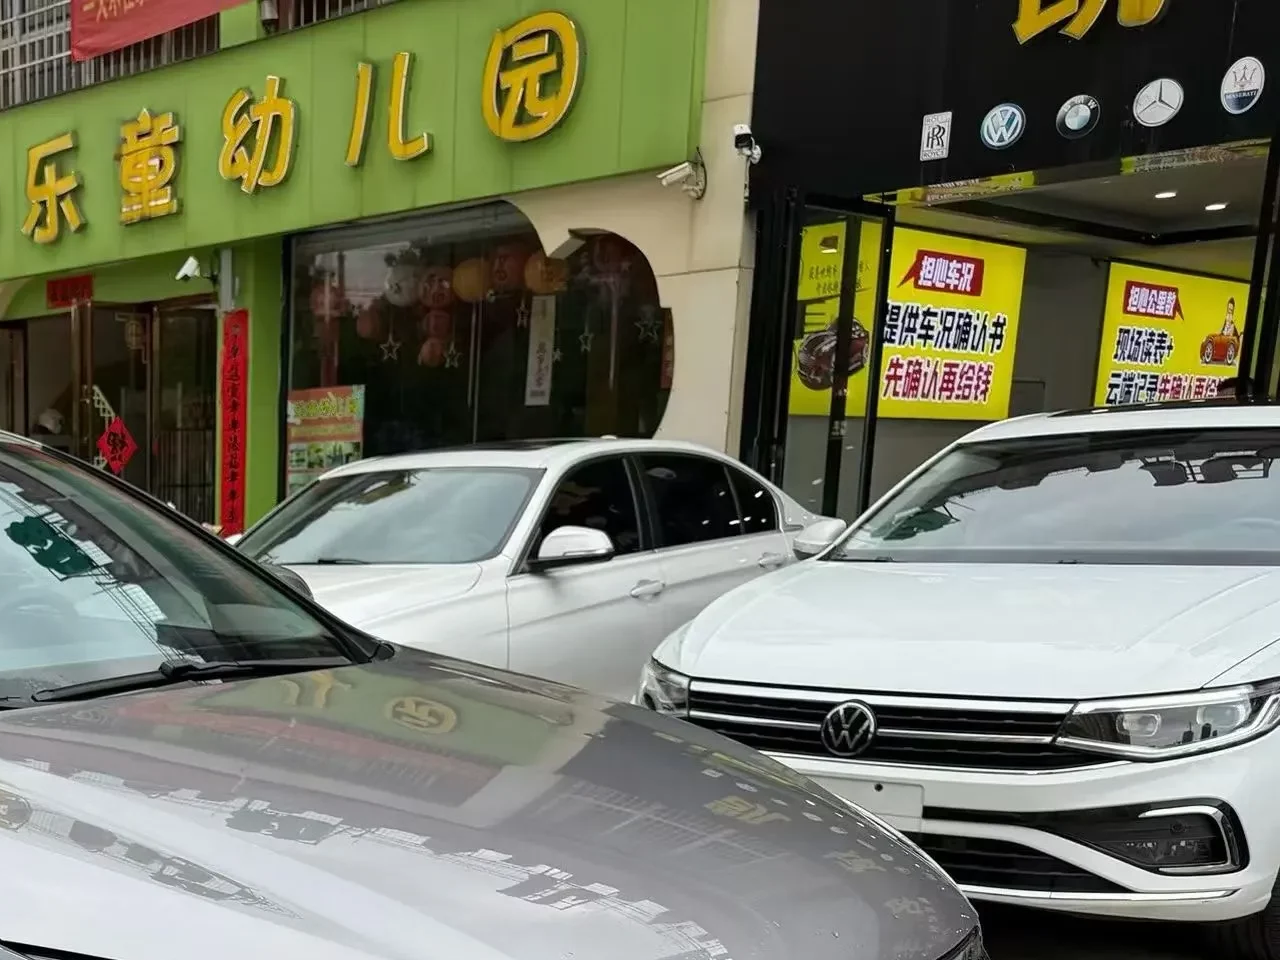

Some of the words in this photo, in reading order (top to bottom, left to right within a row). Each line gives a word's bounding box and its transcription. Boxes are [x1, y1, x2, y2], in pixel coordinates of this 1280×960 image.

[22, 11, 584, 245] 乐童幼儿园
[918, 255, 975, 291] 担心车况
[1128, 286, 1176, 316] 担心公里数
[883, 303, 1007, 354] 提供车况确认书
[883, 357, 993, 402] 先确认再给钱
[1106, 372, 1230, 404] 云端记录先确认再给
